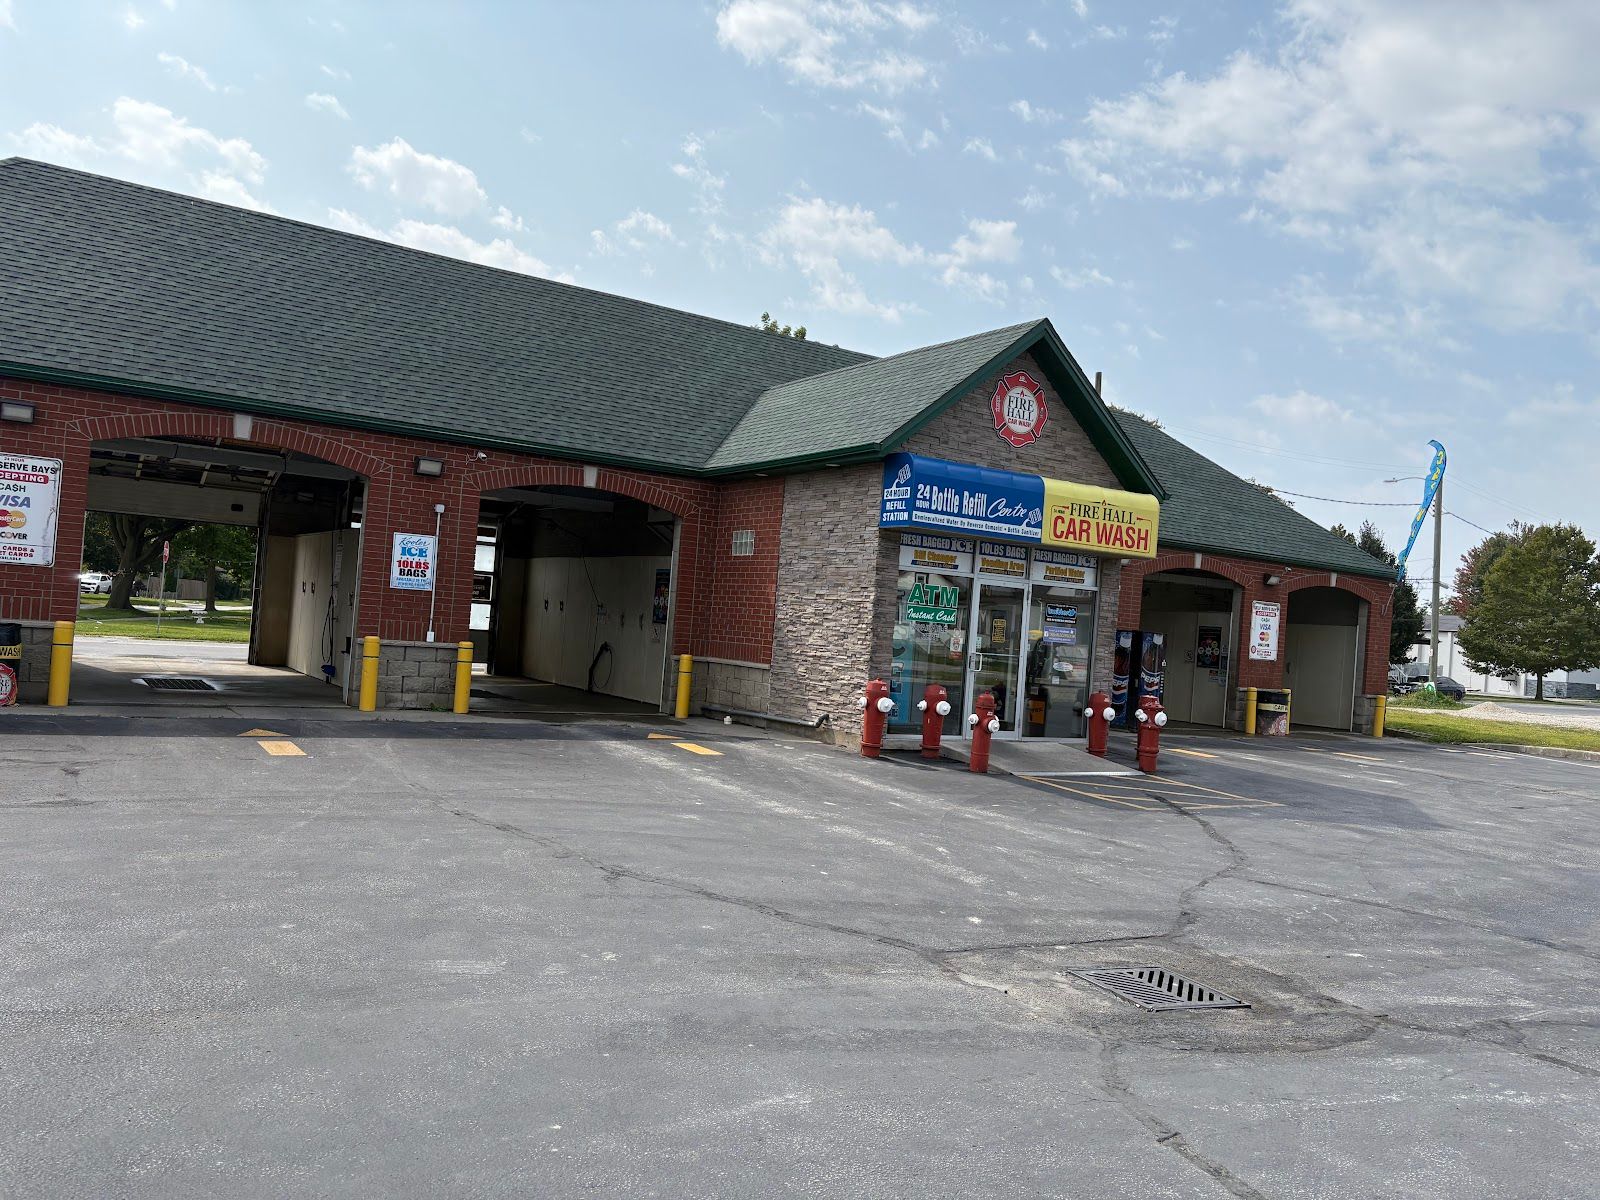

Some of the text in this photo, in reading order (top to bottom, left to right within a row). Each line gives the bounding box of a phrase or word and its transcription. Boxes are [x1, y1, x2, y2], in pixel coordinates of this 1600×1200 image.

[1008, 396, 1034, 412] FIRE
[1007, 407, 1033, 422] HALL
[0, 461, 57, 475] SERVE BAYS
[885, 489, 909, 498] 24 HOUR
[916, 484, 931, 499] 24
[886, 501, 906, 510] REFILL
[915, 500, 930, 509] HOUR
[931, 485, 1028, 519] Bottle Refill Centre
[882, 511, 909, 522] STATION
[1070, 503, 1136, 525] FIRE HALL
[946, 518, 959, 526] Water
[1053, 515, 1149, 551] CAR WASH
[900, 533, 974, 552] FRESH BAGGED ICE
[400, 546, 428, 557] ICE
[981, 543, 1026, 559] 10LBS BAGS
[1033, 549, 1097, 567] FRESH BAGGED ICE
[396, 560, 429, 570] 10LBS
[399, 568, 427, 578] BAGS
[907, 582, 960, 608] ATM
[907, 608, 957, 622] Instant Cash
